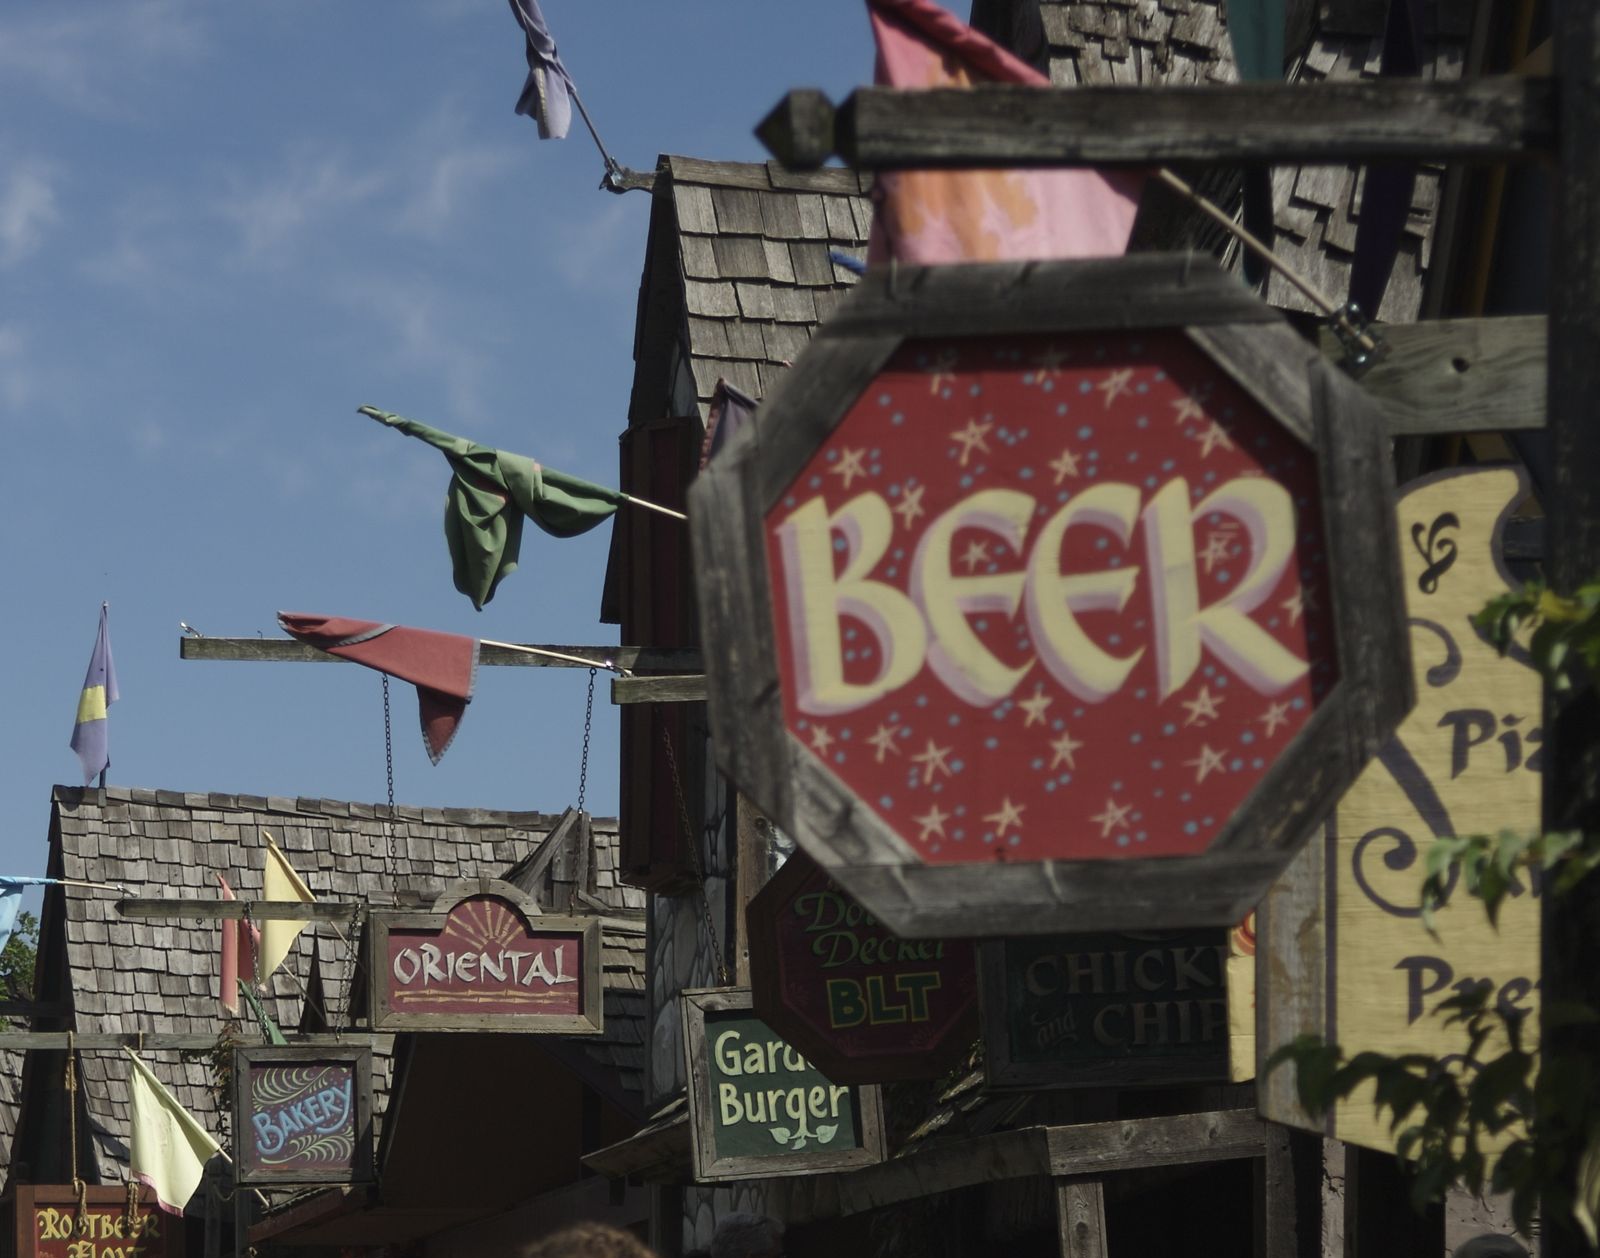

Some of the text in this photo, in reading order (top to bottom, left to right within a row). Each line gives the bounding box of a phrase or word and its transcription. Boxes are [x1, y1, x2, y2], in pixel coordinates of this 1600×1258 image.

[774, 477, 1309, 715] BEER
[393, 943, 577, 986] ORIENTAL
[1394, 956, 1542, 1026] Pre
[826, 971, 941, 1029] BLT
[252, 1078, 353, 1155] BAKERY
[718, 1083, 849, 1136] Burger
